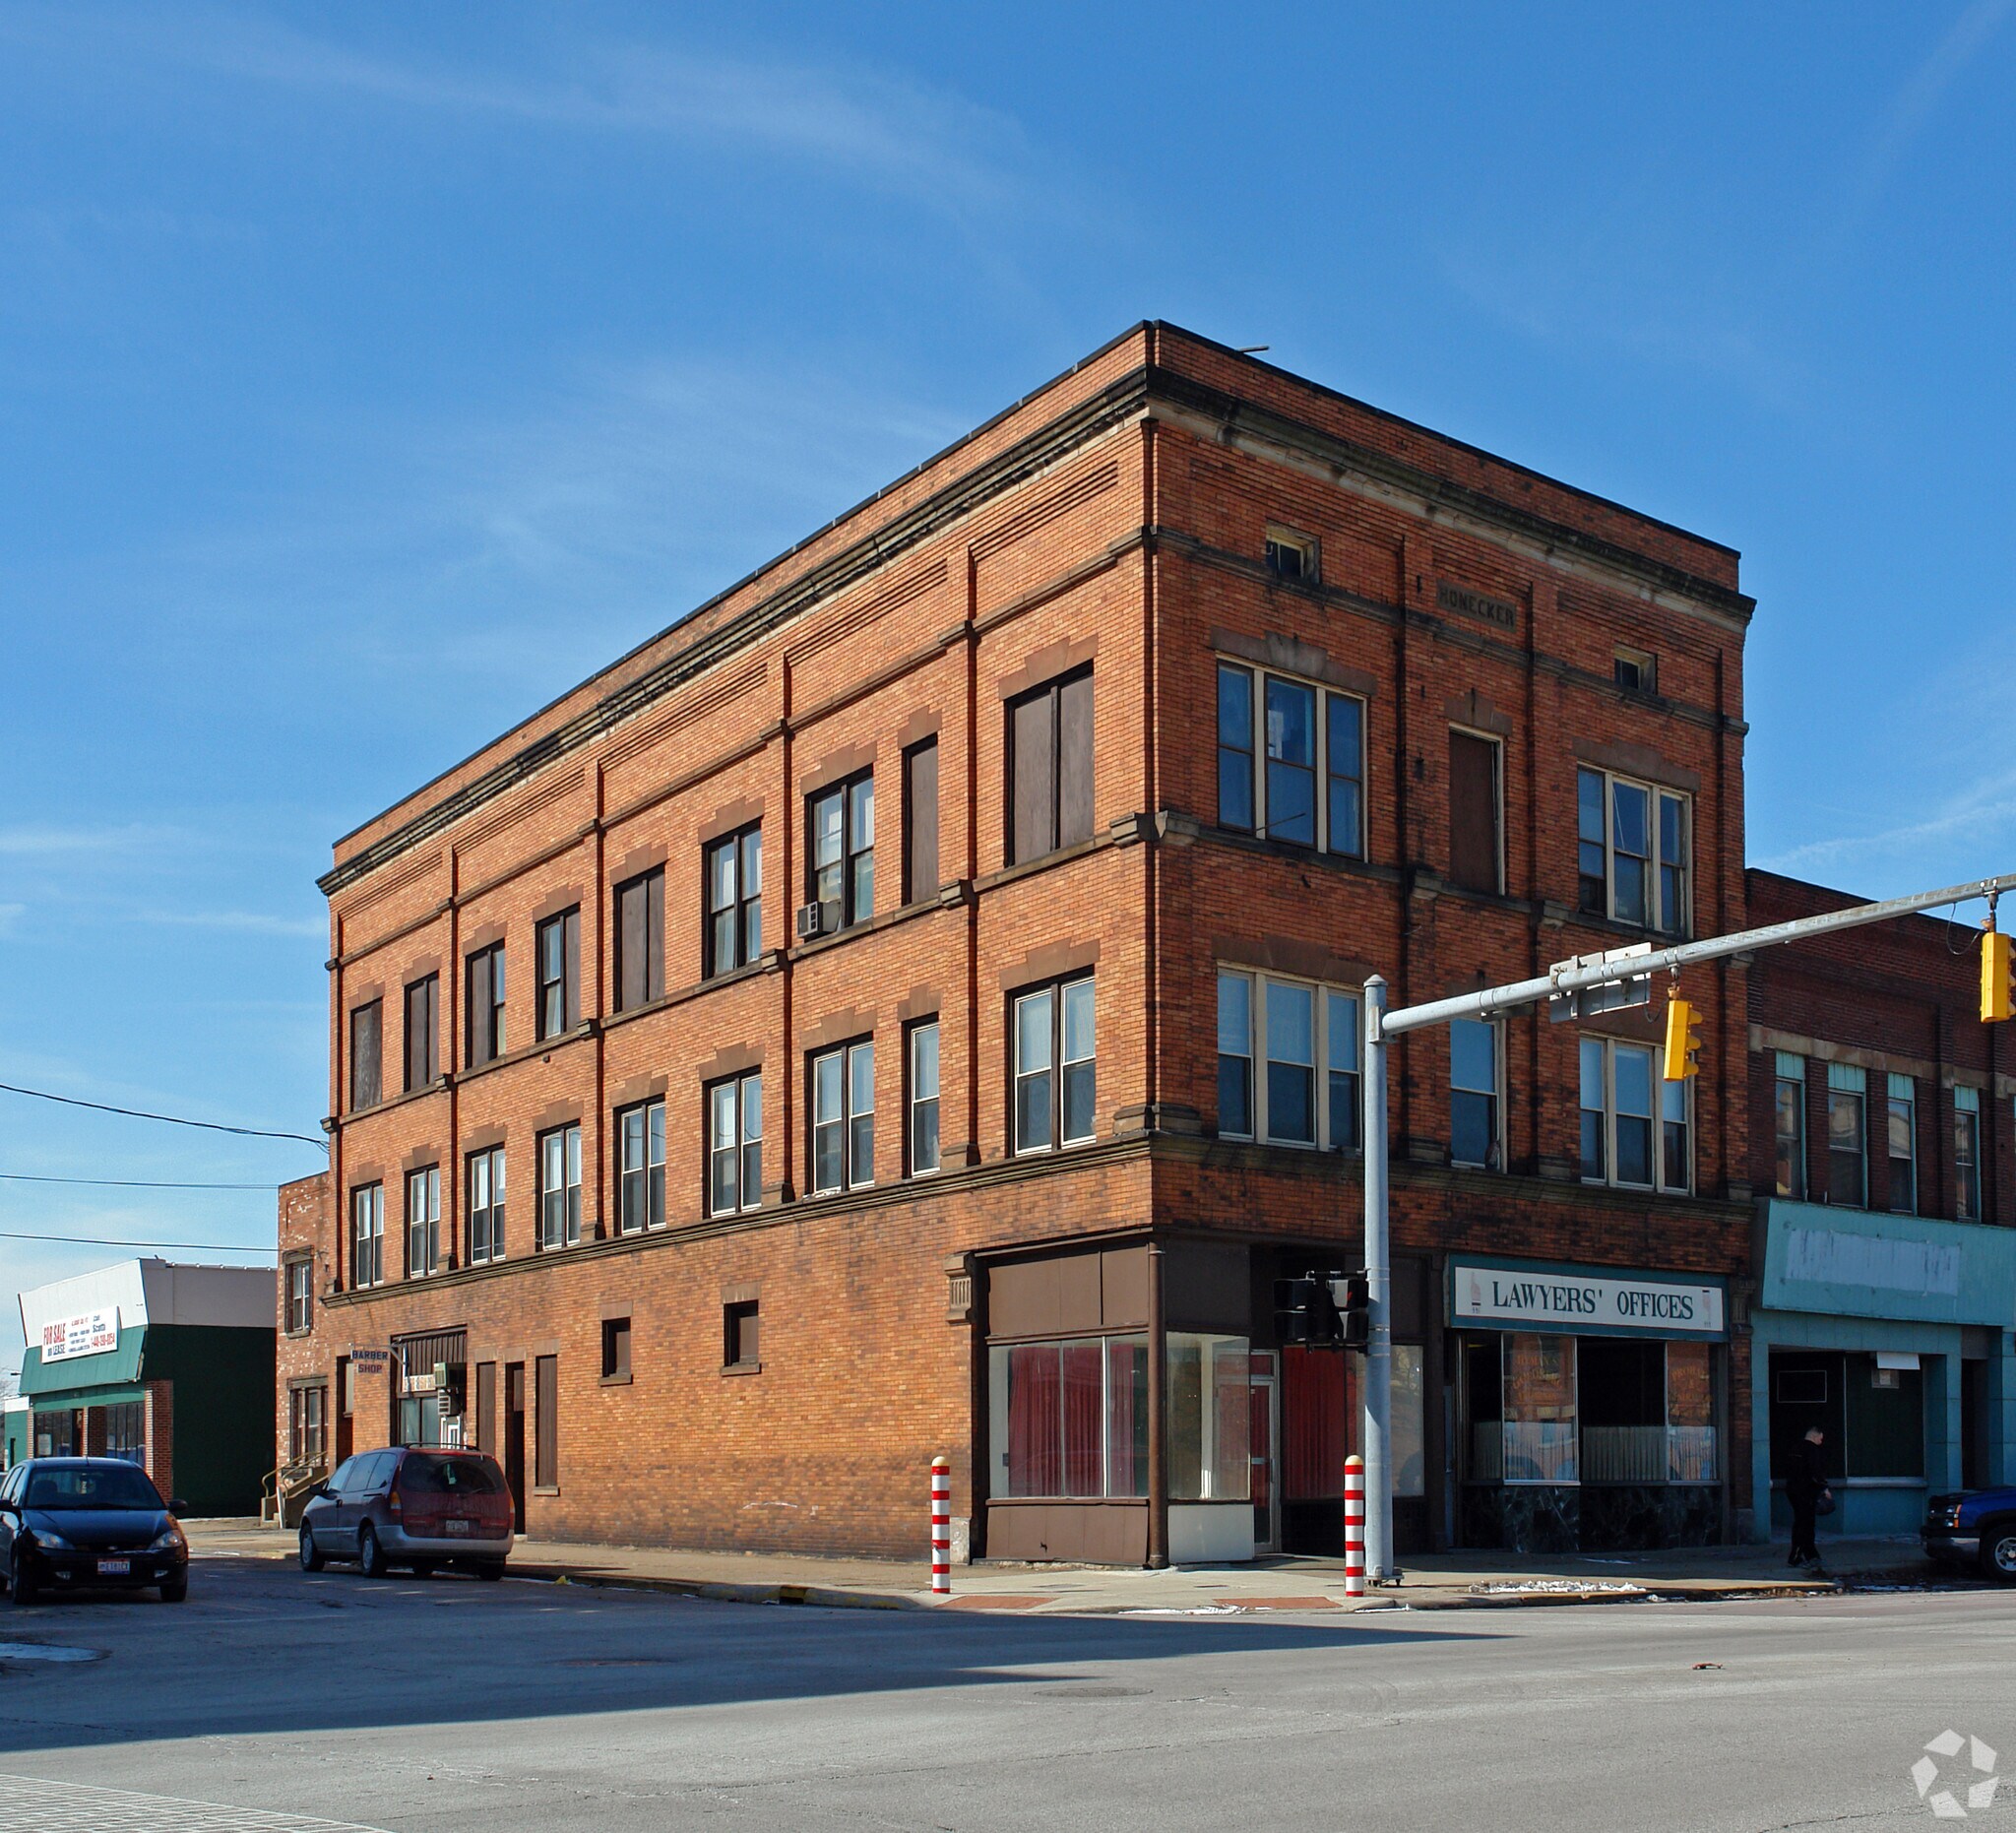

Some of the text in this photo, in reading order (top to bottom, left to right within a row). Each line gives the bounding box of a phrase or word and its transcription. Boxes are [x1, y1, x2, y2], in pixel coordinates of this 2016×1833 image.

[1439, 587, 1514, 627] HONECKER
[1492, 1281, 1694, 1320] LAWYERS' OFFICES
[43, 1325, 53, 1346] FOR
[53, 1323, 66, 1344] SALE
[53, 1344, 65, 1356] LEASE
[351, 1350, 389, 1359] BARBER
[357, 1363, 383, 1373] SHOP
